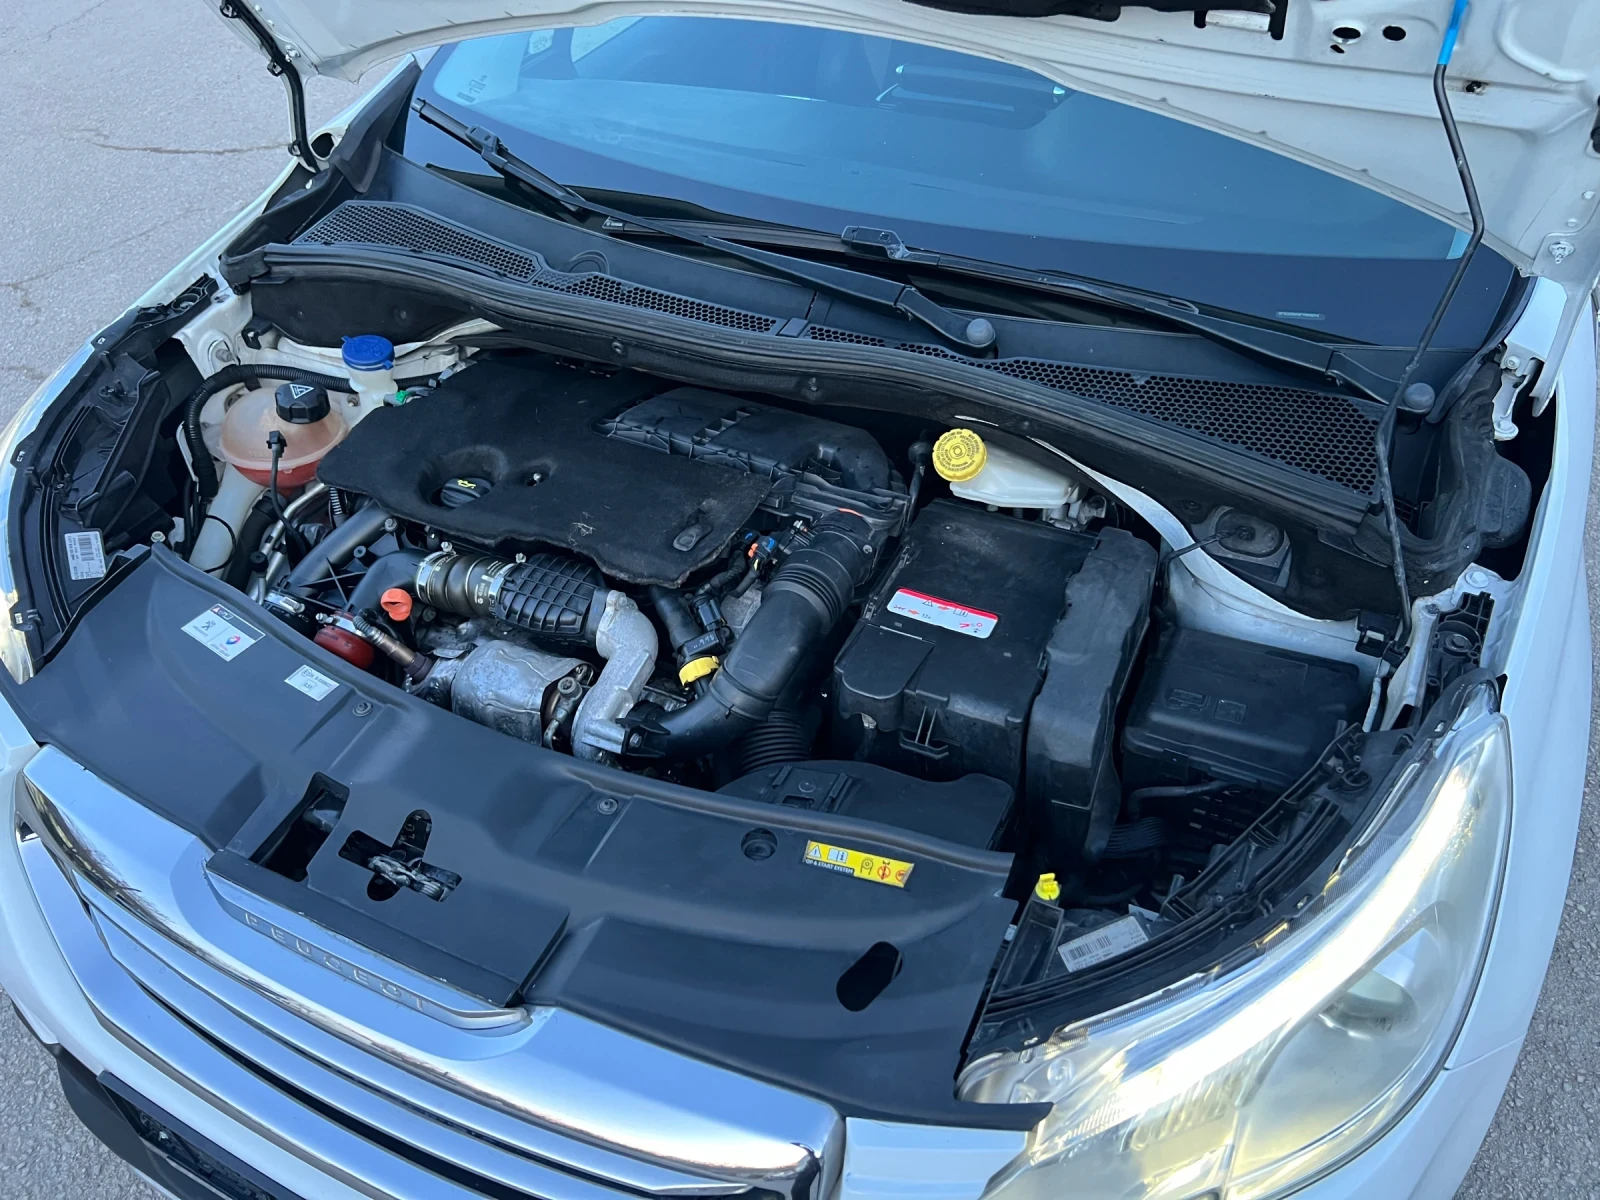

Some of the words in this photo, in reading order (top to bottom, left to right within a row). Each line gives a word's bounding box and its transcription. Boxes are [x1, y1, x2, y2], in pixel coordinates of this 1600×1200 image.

[818, 861, 833, 869] START
[834, 865, 853, 874] SYSTEM
[244, 911, 428, 1011] PEUGEOT
